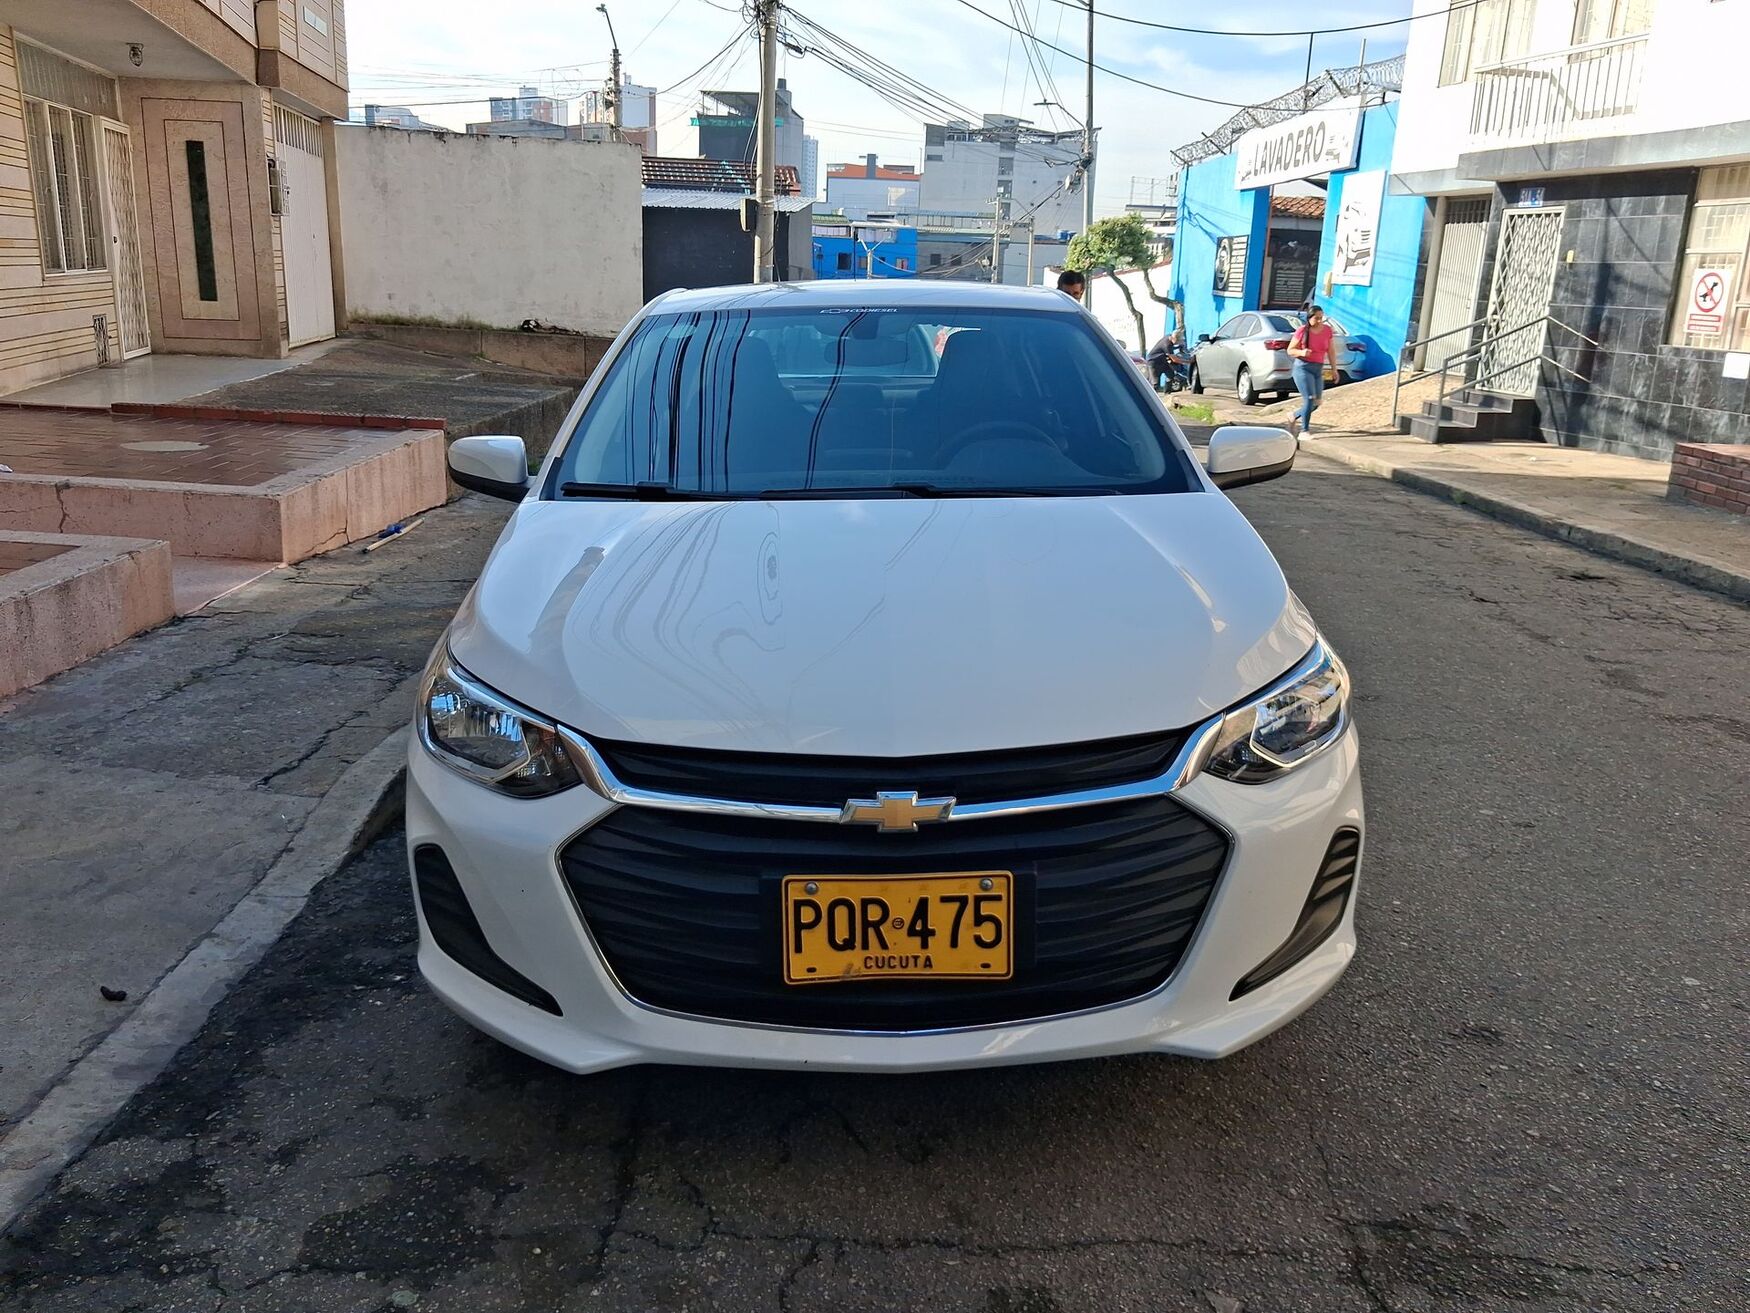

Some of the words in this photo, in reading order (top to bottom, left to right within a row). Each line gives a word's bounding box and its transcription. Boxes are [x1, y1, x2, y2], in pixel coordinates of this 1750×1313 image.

[1253, 120, 1326, 177] LAVADERO
[793, 896, 889, 953] PQR
[907, 894, 1003, 950] 475
[863, 954, 934, 970] CUCUTA
